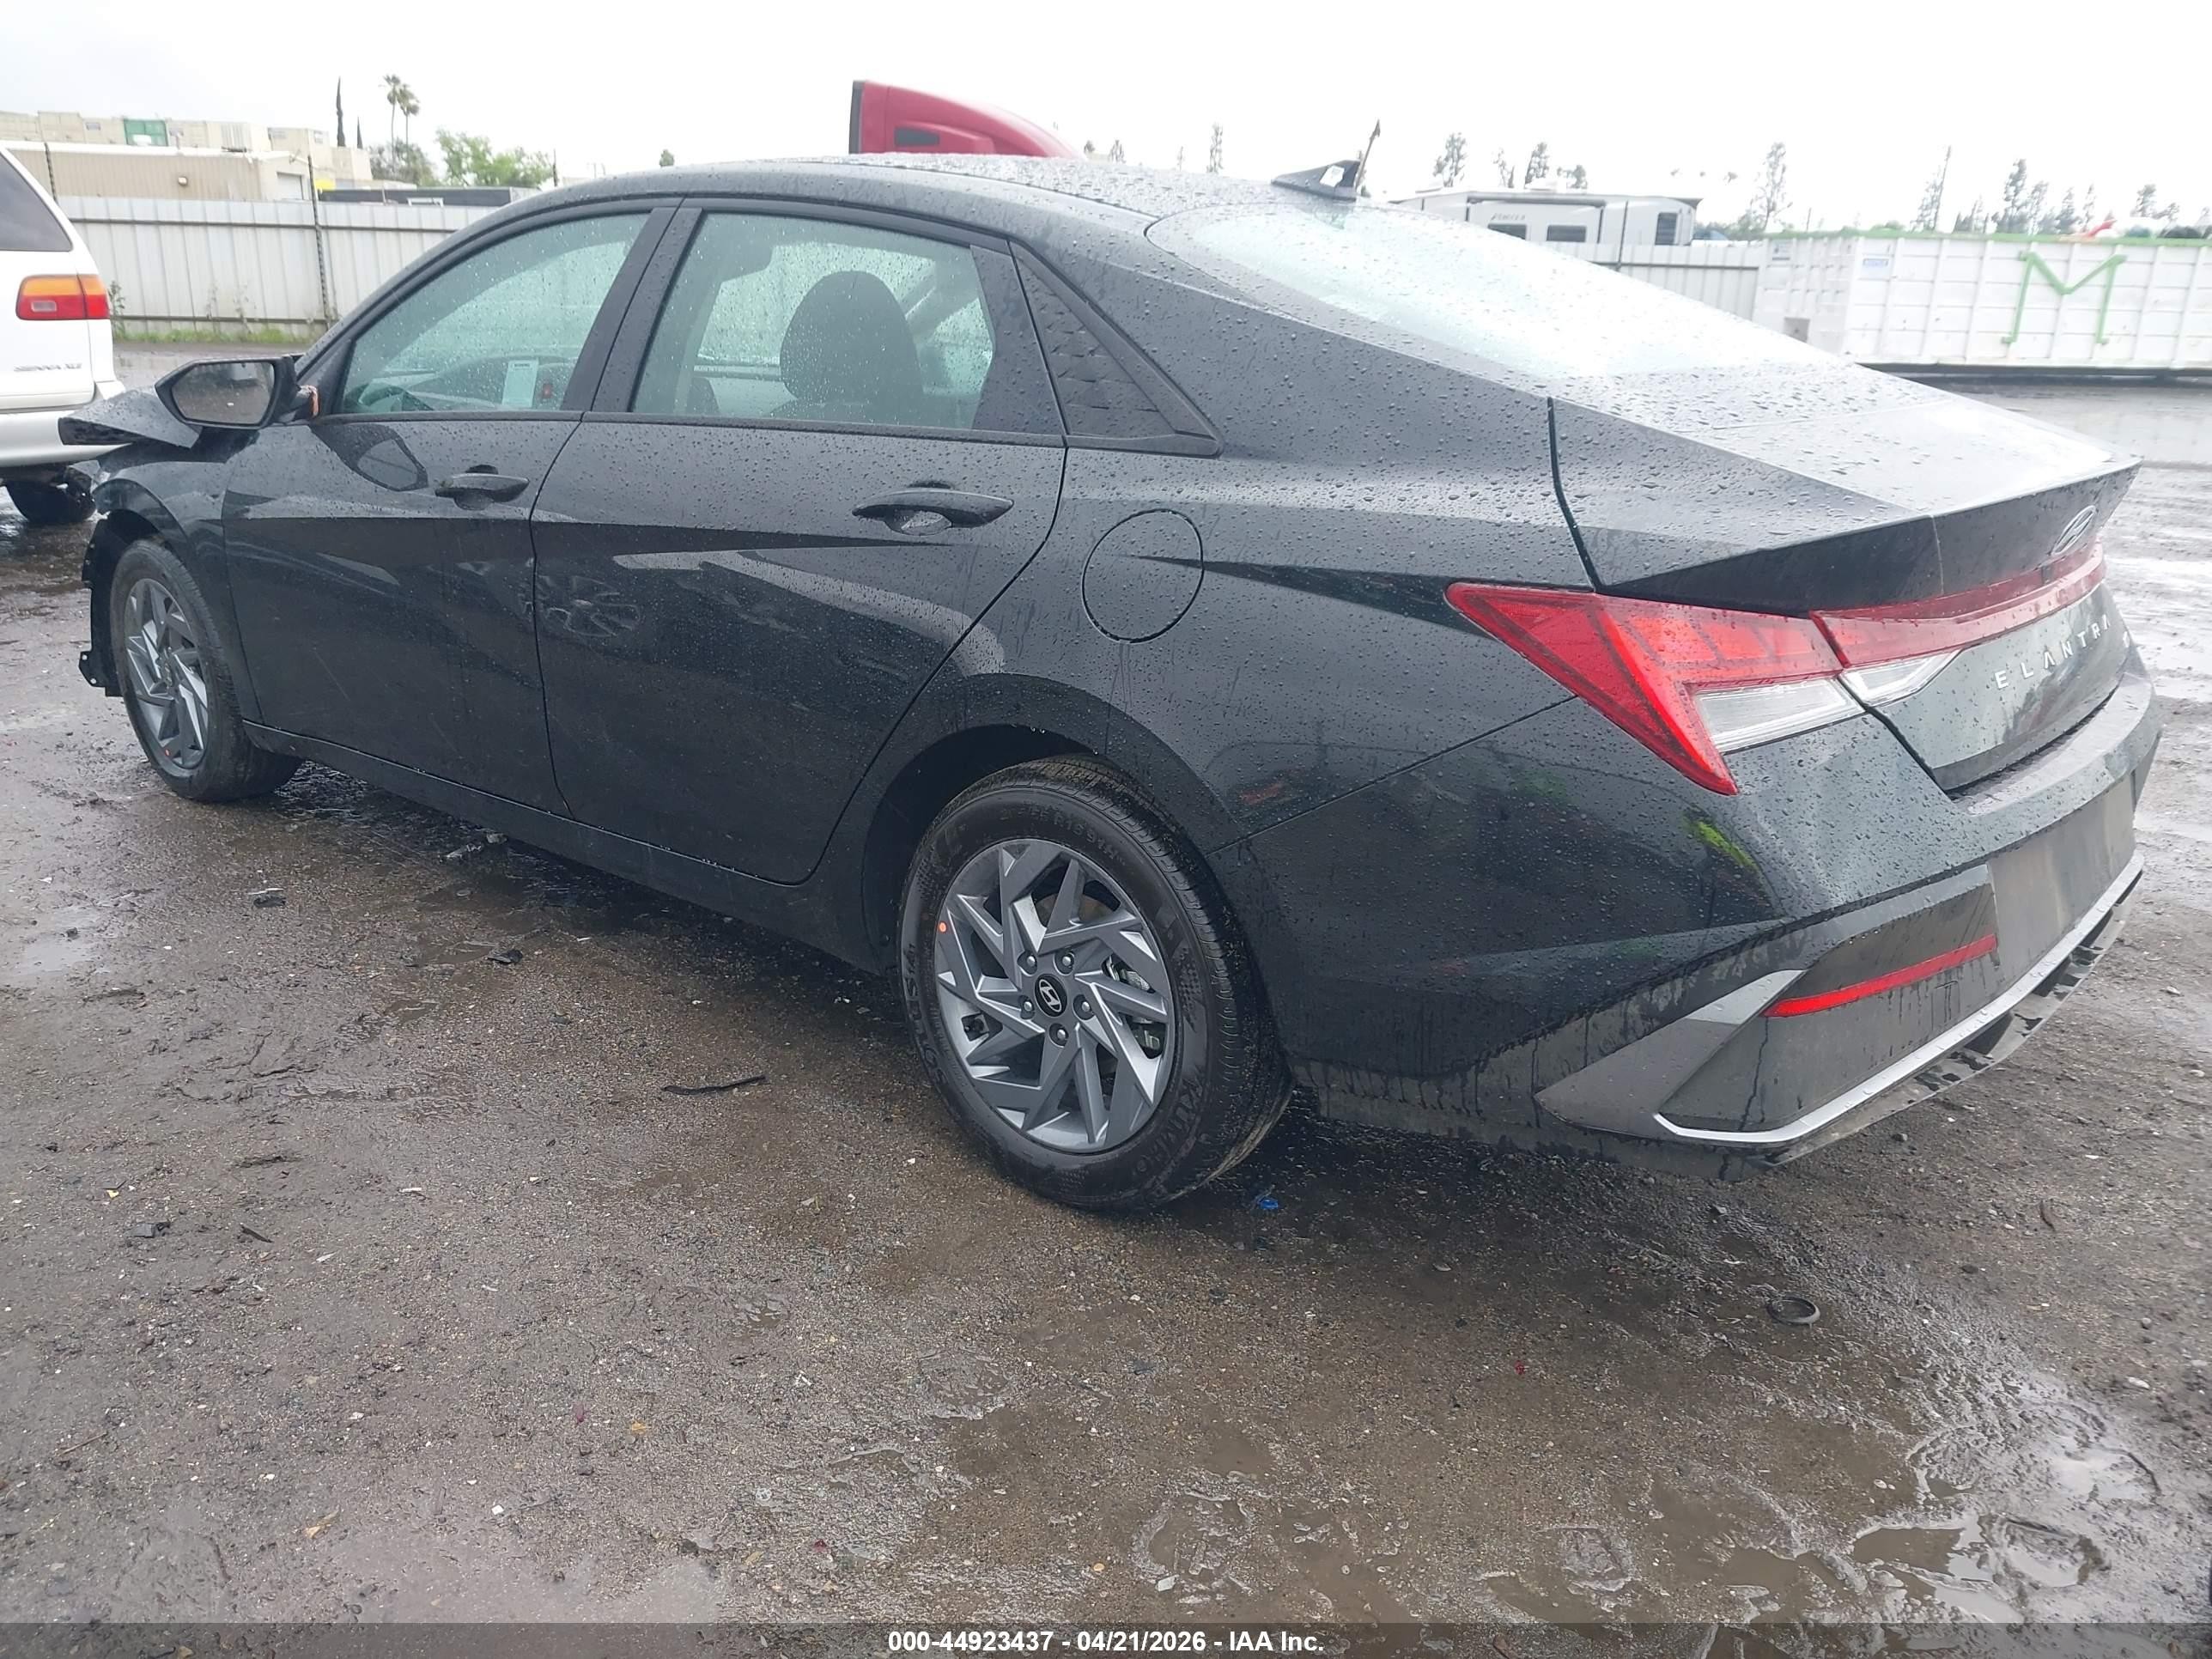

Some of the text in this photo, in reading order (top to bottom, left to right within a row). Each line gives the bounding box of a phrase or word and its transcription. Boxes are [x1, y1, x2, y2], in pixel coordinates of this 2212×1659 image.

[2001, 250, 2128, 345] M
[1994, 613, 2112, 689] ELANTRA
[1136, 1071, 1203, 1173] KUMHO
